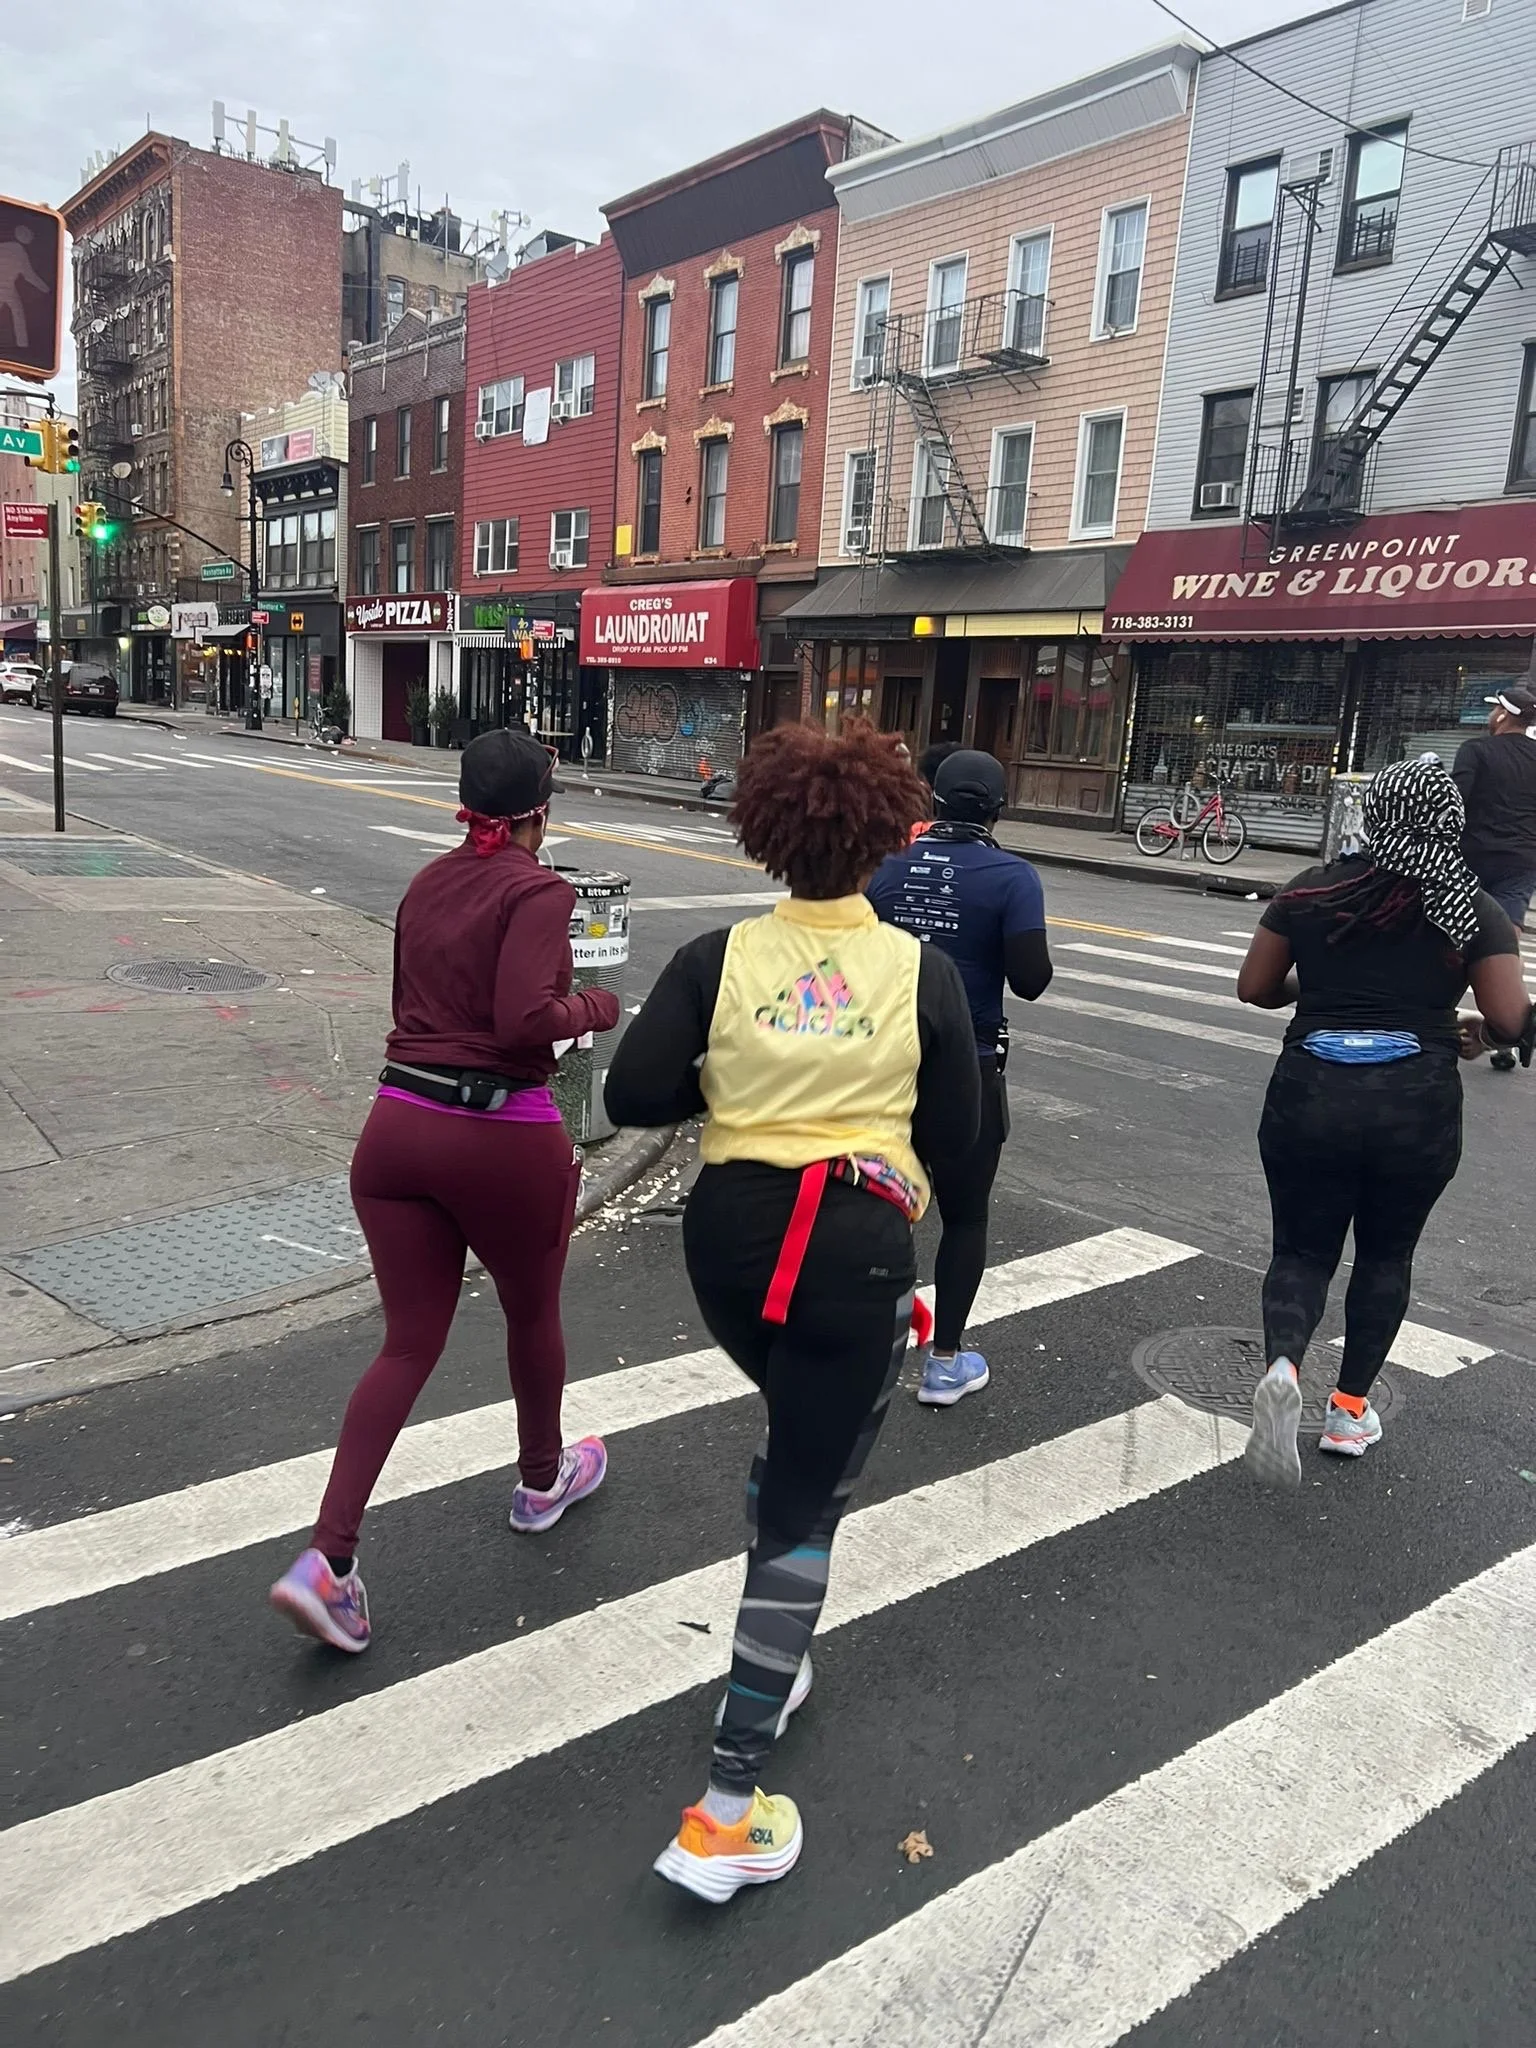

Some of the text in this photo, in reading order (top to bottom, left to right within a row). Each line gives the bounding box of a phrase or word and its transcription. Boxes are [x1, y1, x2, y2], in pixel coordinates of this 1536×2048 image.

[3, 433, 25, 449] Av
[5, 506, 15, 514] NO
[6, 514, 34, 522] Anytime
[1269, 534, 1460, 564] GREENPOINT
[1172, 570, 1280, 600] WINE
[1286, 569, 1325, 597] &
[446, 593, 454, 631] PIZZA
[629, 597, 673, 611] CREG'S
[355, 599, 384, 629] Upside
[385, 600, 432, 625] PIZZA
[595, 612, 709, 643] LAUNDROMAT
[1111, 615, 1194, 629] 718-383-3131
[1206, 743, 1277, 758] AMERICA'S
[588, 888, 611, 896] litter
[598, 947, 607, 957] in
[609, 946, 620, 956] its
[755, 1004, 874, 1038] adidas
